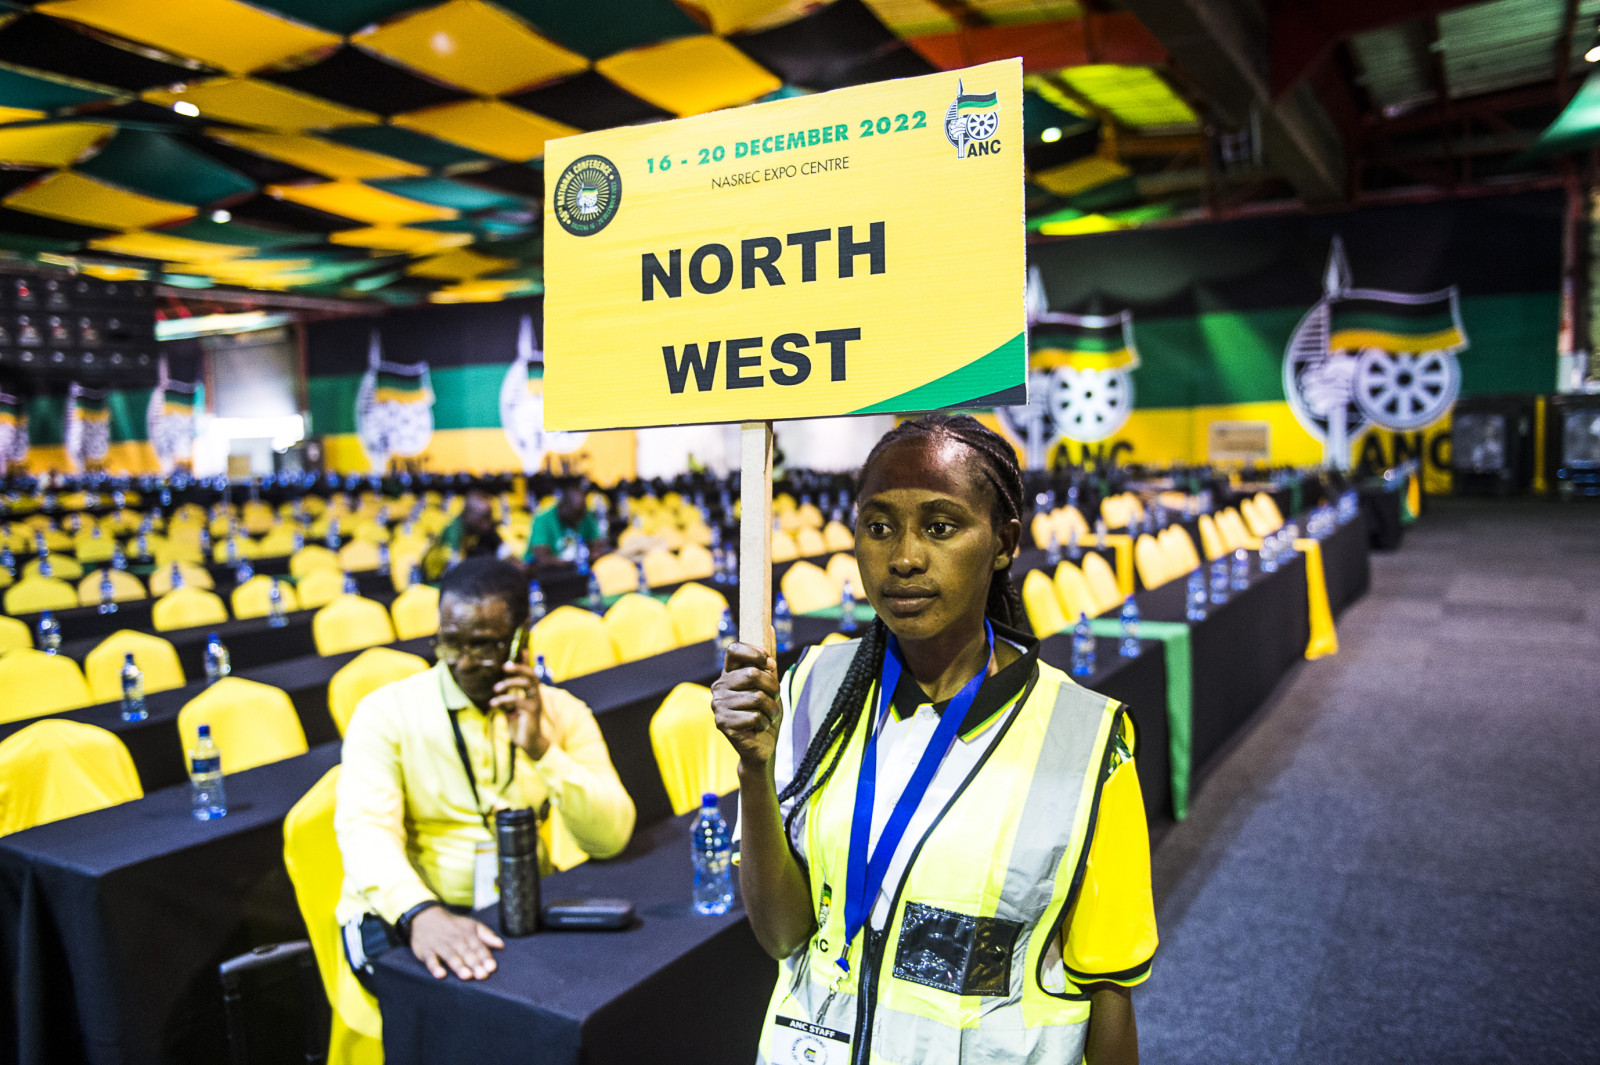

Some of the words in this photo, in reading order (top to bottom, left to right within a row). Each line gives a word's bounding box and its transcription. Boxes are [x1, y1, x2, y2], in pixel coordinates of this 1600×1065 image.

[647, 155, 672, 174] 16
[697, 145, 725, 166] 20
[735, 123, 849, 159] DECEMBER
[858, 110, 927, 138] 2022
[967, 139, 1002, 158] ANC
[557, 171, 575, 206] NATIONAL
[572, 160, 613, 176] CONFERENCE
[711, 170, 761, 189] NASREC
[764, 164, 797, 181] EXPO
[800, 156, 849, 176] CENTRE
[641, 221, 886, 302] NORTH
[661, 327, 862, 394] WEST
[789, 1020, 808, 1031] ANC
[809, 1025, 836, 1038] STAFF
